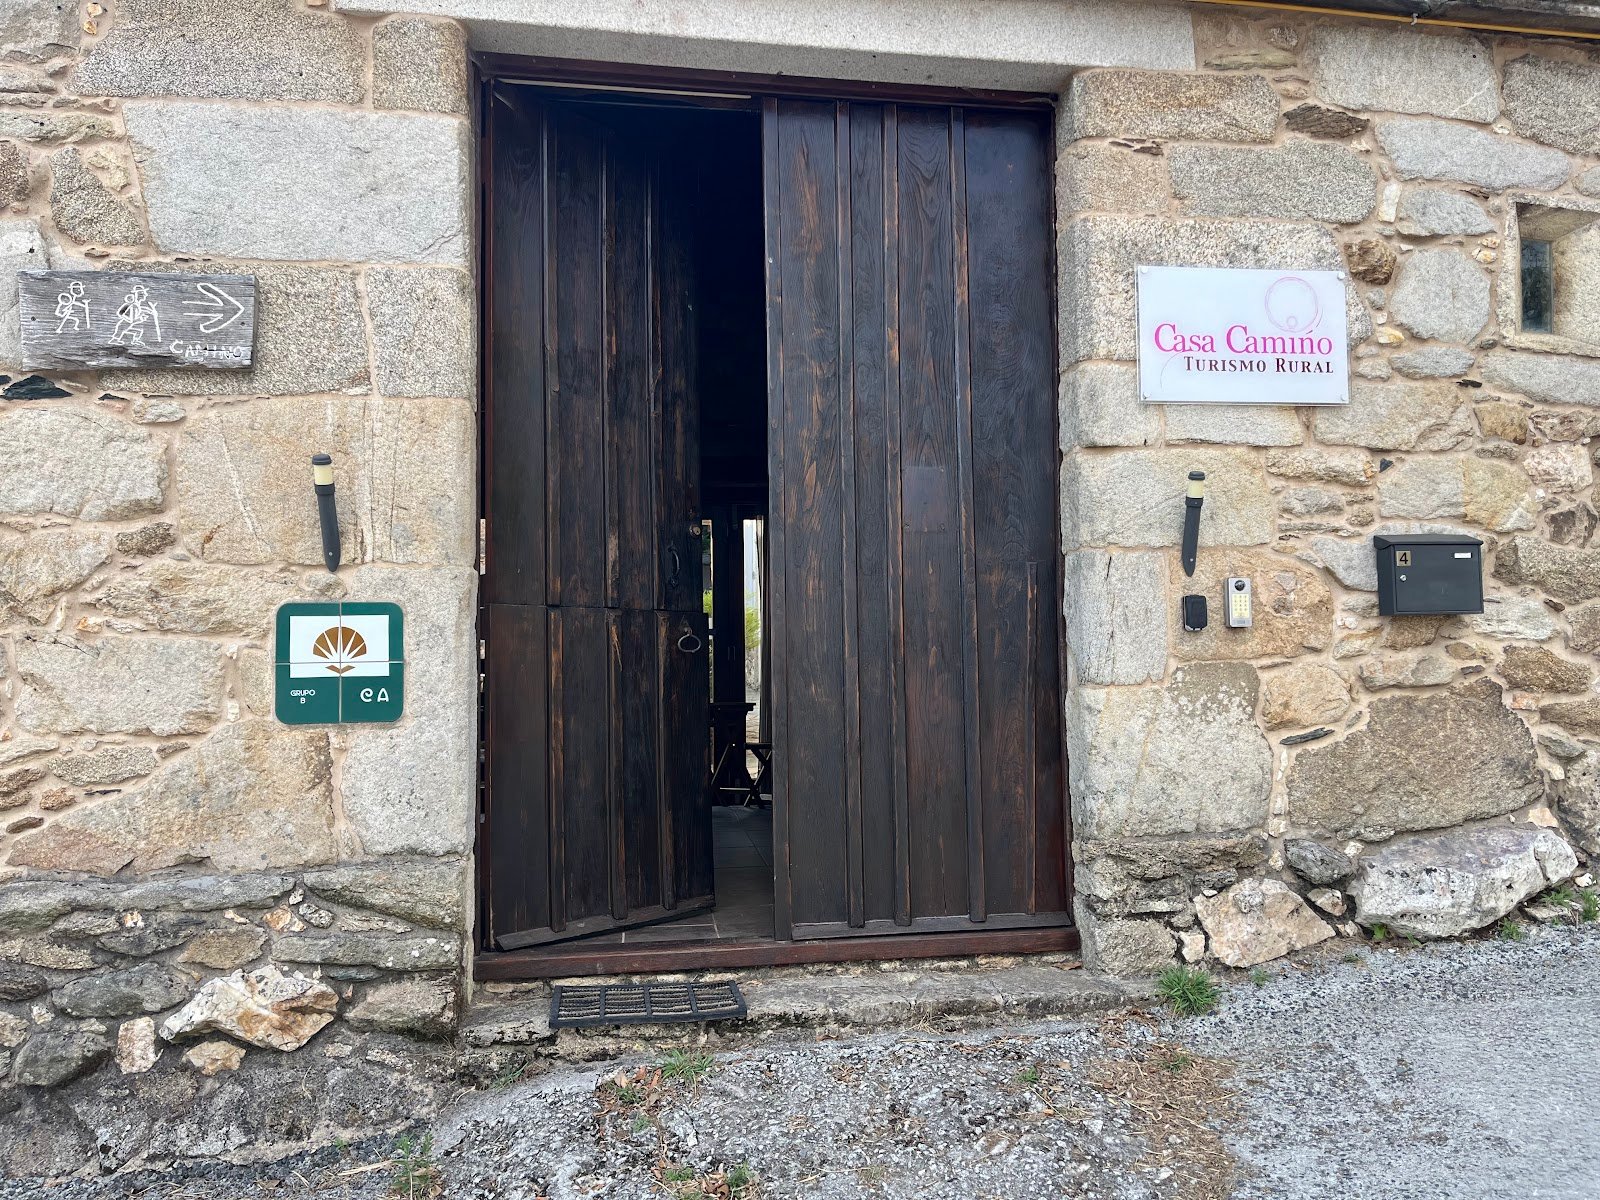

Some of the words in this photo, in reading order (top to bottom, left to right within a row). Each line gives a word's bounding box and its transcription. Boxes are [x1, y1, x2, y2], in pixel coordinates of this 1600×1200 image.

[1154, 323, 1217, 353] Casa
[1399, 551, 1409, 565] 4
[290, 689, 316, 697] GRUPO
